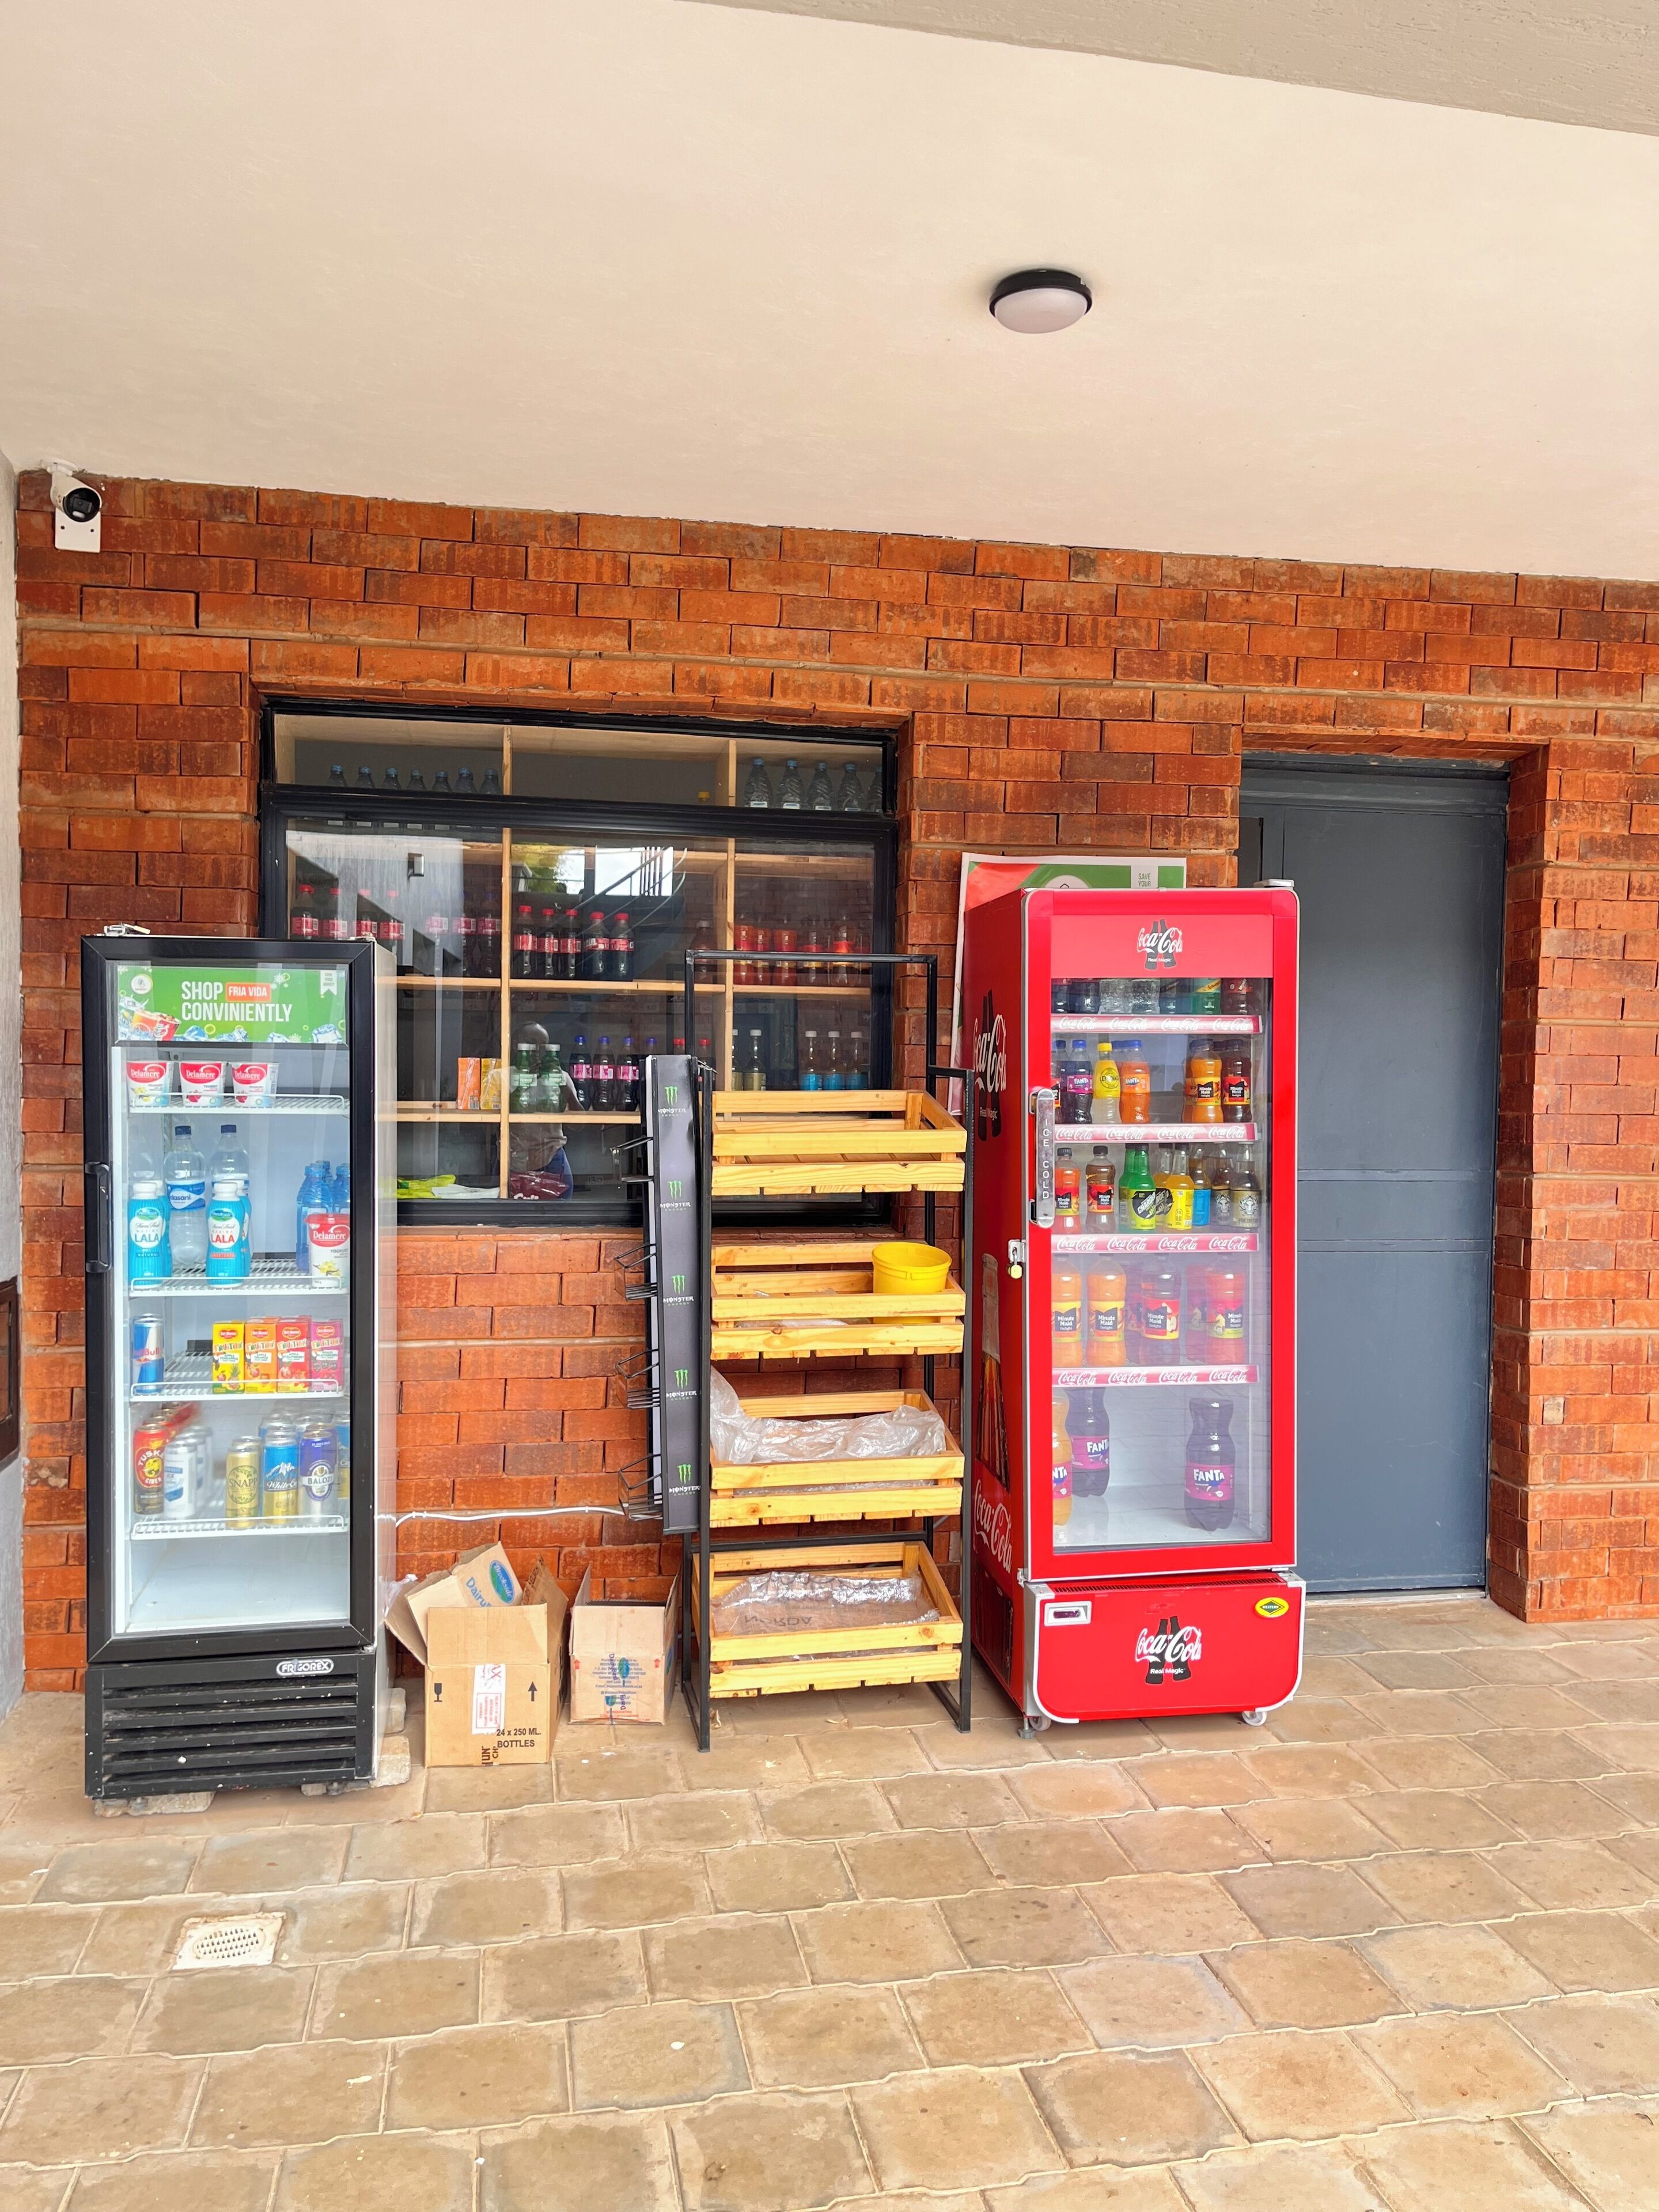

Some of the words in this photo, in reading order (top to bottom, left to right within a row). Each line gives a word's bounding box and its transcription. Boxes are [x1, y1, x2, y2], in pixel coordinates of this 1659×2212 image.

[1137, 927, 1183, 954] Coca-Cola
[181, 981, 223, 1000] SHOP
[228, 986, 246, 997] FRIA
[249, 986, 267, 997] VIDA
[181, 1002, 293, 1022] CONVINIENTLY
[972, 1014, 1006, 1093] Coca-Cola
[131, 1069, 160, 1078] Delamere
[186, 1069, 215, 1078] Delamere
[234, 1070, 260, 1079] Delamere
[987, 1107, 998, 1121] Magic
[1056, 1127, 1093, 1140] Coca-Cola
[1106, 1127, 1145, 1140] Coca-Cola
[1157, 1126, 1196, 1139] Coca-Cola
[1209, 1126, 1245, 1138] Coca-Cola
[135, 1234, 160, 1243] LALA
[211, 1234, 235, 1243] LALA
[313, 1230, 346, 1240] Delamere
[1057, 1237, 1097, 1251] Coca-Cola
[1107, 1237, 1148, 1251] Coca-Cola
[1158, 1237, 1199, 1250] Coca-Cola
[1209, 1236, 1249, 1250] Coca-Cola
[1058, 1371, 1097, 1385] Coca-Cola
[1108, 1370, 1148, 1385] Coca-Cola
[1159, 1369, 1198, 1383] Coca-Cola
[1209, 1368, 1249, 1383] Coca-Cola
[666, 1390, 697, 1398] MONSTER
[138, 1449, 164, 1466] TUSK
[1052, 1466, 1067, 1479] NTA
[1194, 1468, 1225, 1482] FANTA
[229, 1478, 257, 1488] SNAPP
[267, 1480, 289, 1490] White
[308, 1476, 333, 1484] BALOZI
[669, 1485, 700, 1493] MONSTER
[974, 1479, 1012, 1573] Coca-Cola
[494, 1562, 513, 1598] Brookside
[1135, 1626, 1202, 1662] Coca-Cola
[282, 1662, 329, 1672] FRIGOREX
[528, 1728, 541, 1736] ML.
[497, 1740, 535, 1748] BOTTLES
